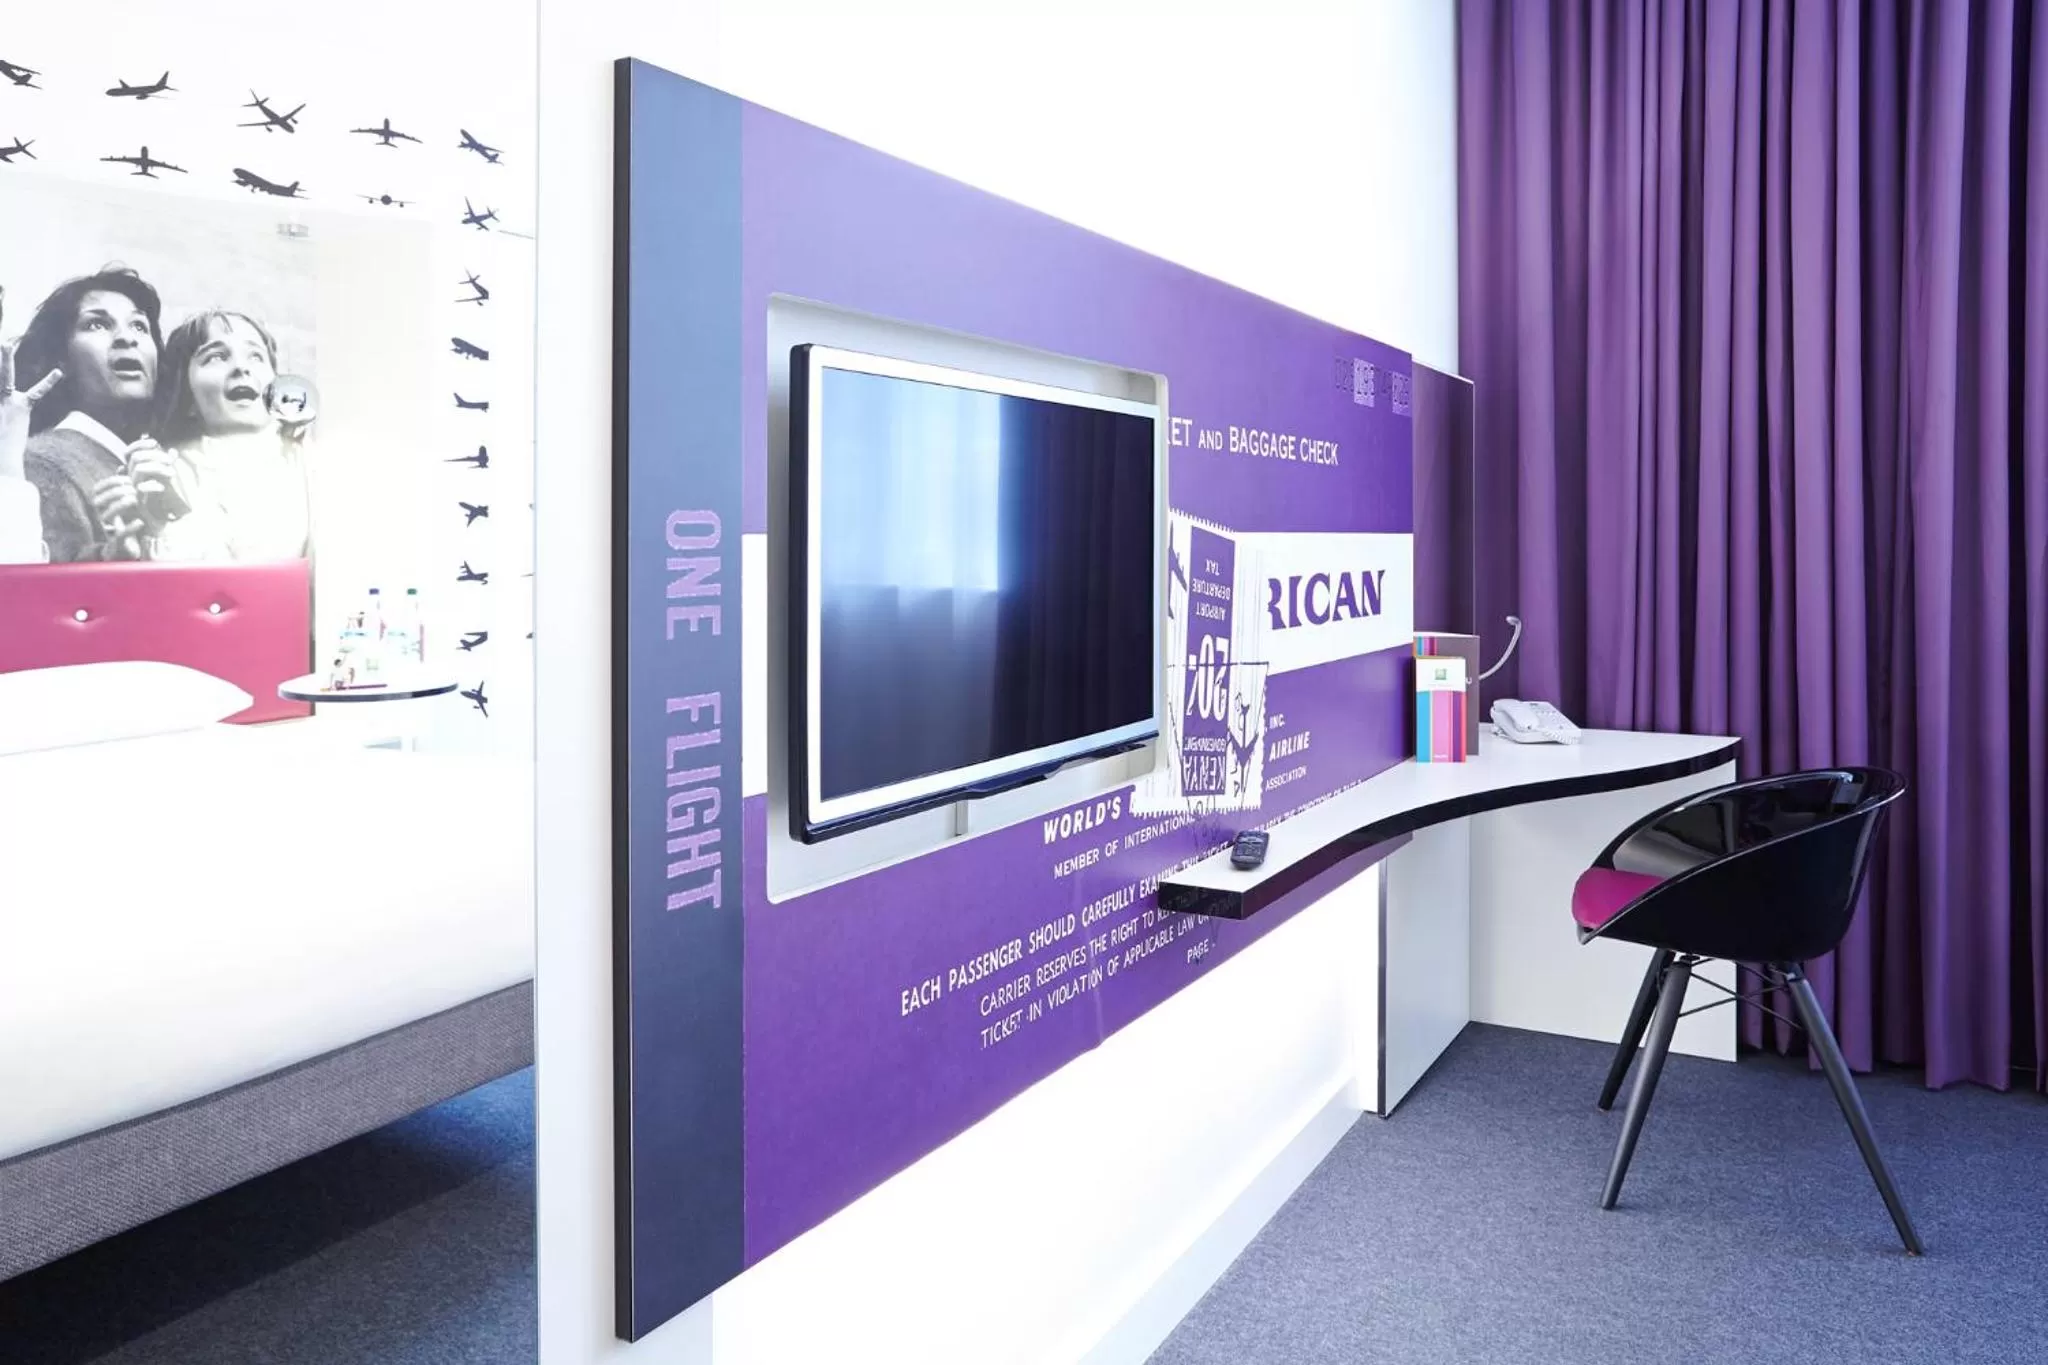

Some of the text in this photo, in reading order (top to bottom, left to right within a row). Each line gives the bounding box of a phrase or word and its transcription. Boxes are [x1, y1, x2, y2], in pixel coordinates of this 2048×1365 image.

[1199, 429, 1223, 450] AND
[1229, 426, 1296, 460] BAGGAGE
[1300, 438, 1339, 466] CHECK
[1205, 559, 1220, 576] TAX
[1192, 578, 1231, 600] DEPARTURE
[1196, 601, 1226, 621] AIRPORT
[665, 509, 722, 911] ONE FLIGHT
[1269, 731, 1311, 762] AIRLINE
[1183, 755, 1226, 791] KENYA
[1265, 765, 1307, 791] ASSOCIATION
[1043, 796, 1122, 844] WORLD'S
[1053, 812, 1195, 879] MEMBER OF INTERNATIONAL
[902, 975, 941, 1016] EACH
[949, 939, 1022, 992] PASSENGER
[1029, 913, 1075, 954] SHOULD
[1082, 884, 1135, 927] CAREFULLY
[980, 974, 1031, 1017] CARRIER
[1036, 946, 1086, 987] RESERVES
[1089, 933, 1107, 958] THE
[1111, 917, 1139, 947] RIGHT
[1142, 910, 1154, 928] TO
[1048, 966, 1102, 1010] VIOLATION
[1107, 955, 1119, 976] OF
[1124, 926, 1173, 968] APPLICABLE
[1177, 914, 1195, 936] LAW
[1187, 939, 1209, 964] PAGE
